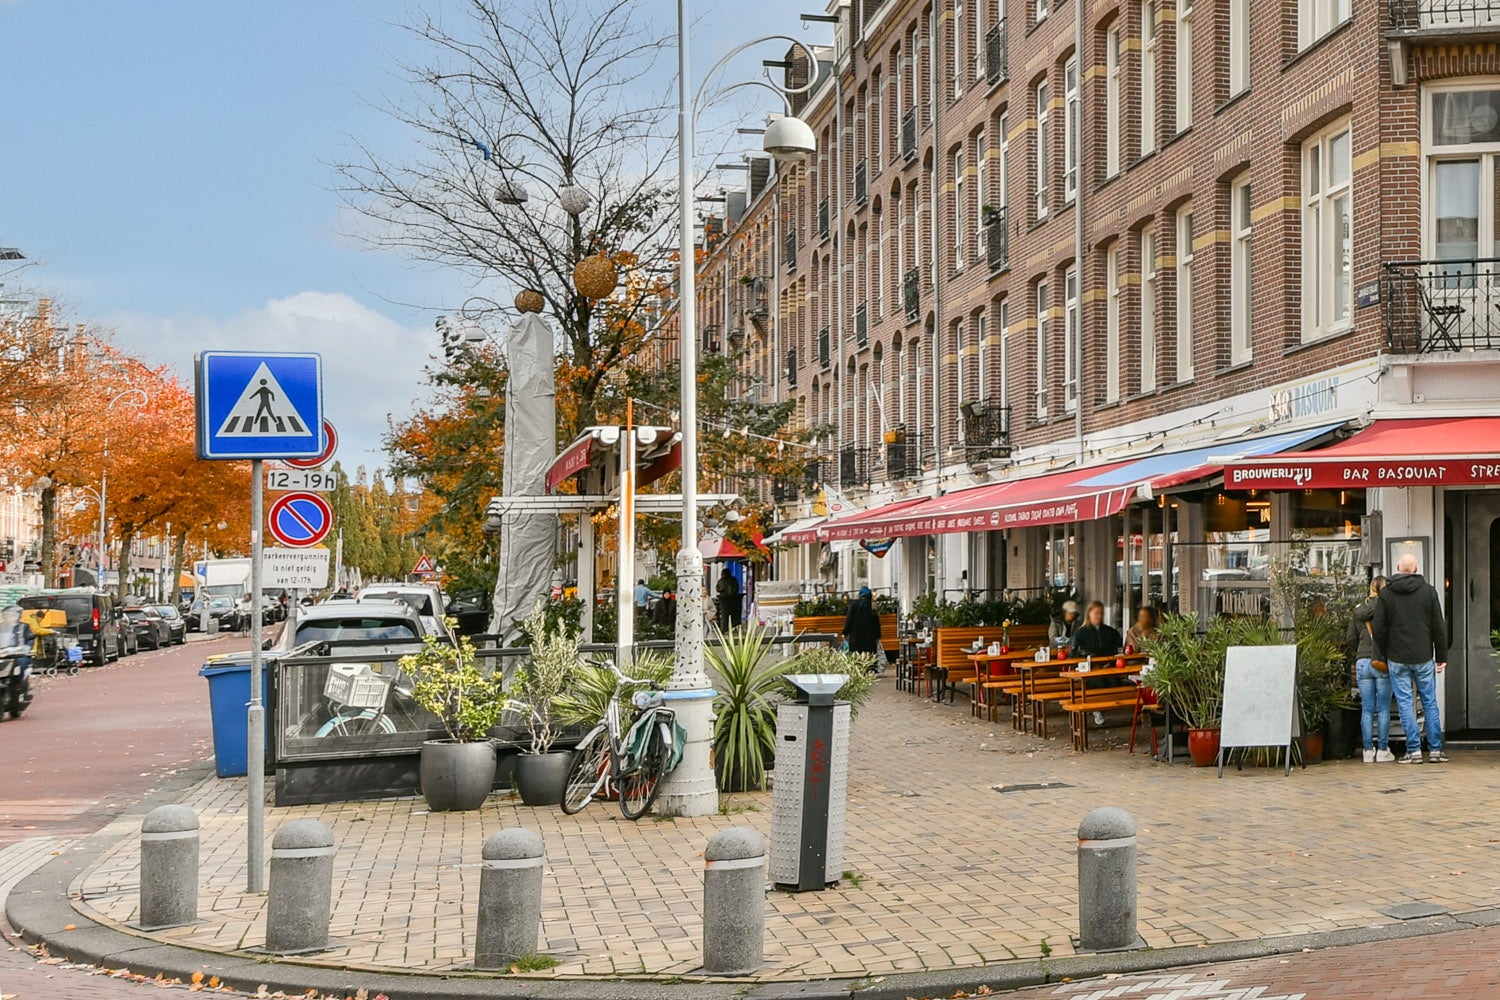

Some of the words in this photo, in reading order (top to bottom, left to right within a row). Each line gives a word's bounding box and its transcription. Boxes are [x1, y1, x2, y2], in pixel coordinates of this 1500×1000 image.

[1295, 377, 1339, 418] BASQUIAT
[1233, 468, 1294, 483] BROUWERIJ
[1343, 468, 1370, 481] BAR
[1378, 466, 1447, 480] BASQUIAT
[296, 564, 317, 574] geldig
